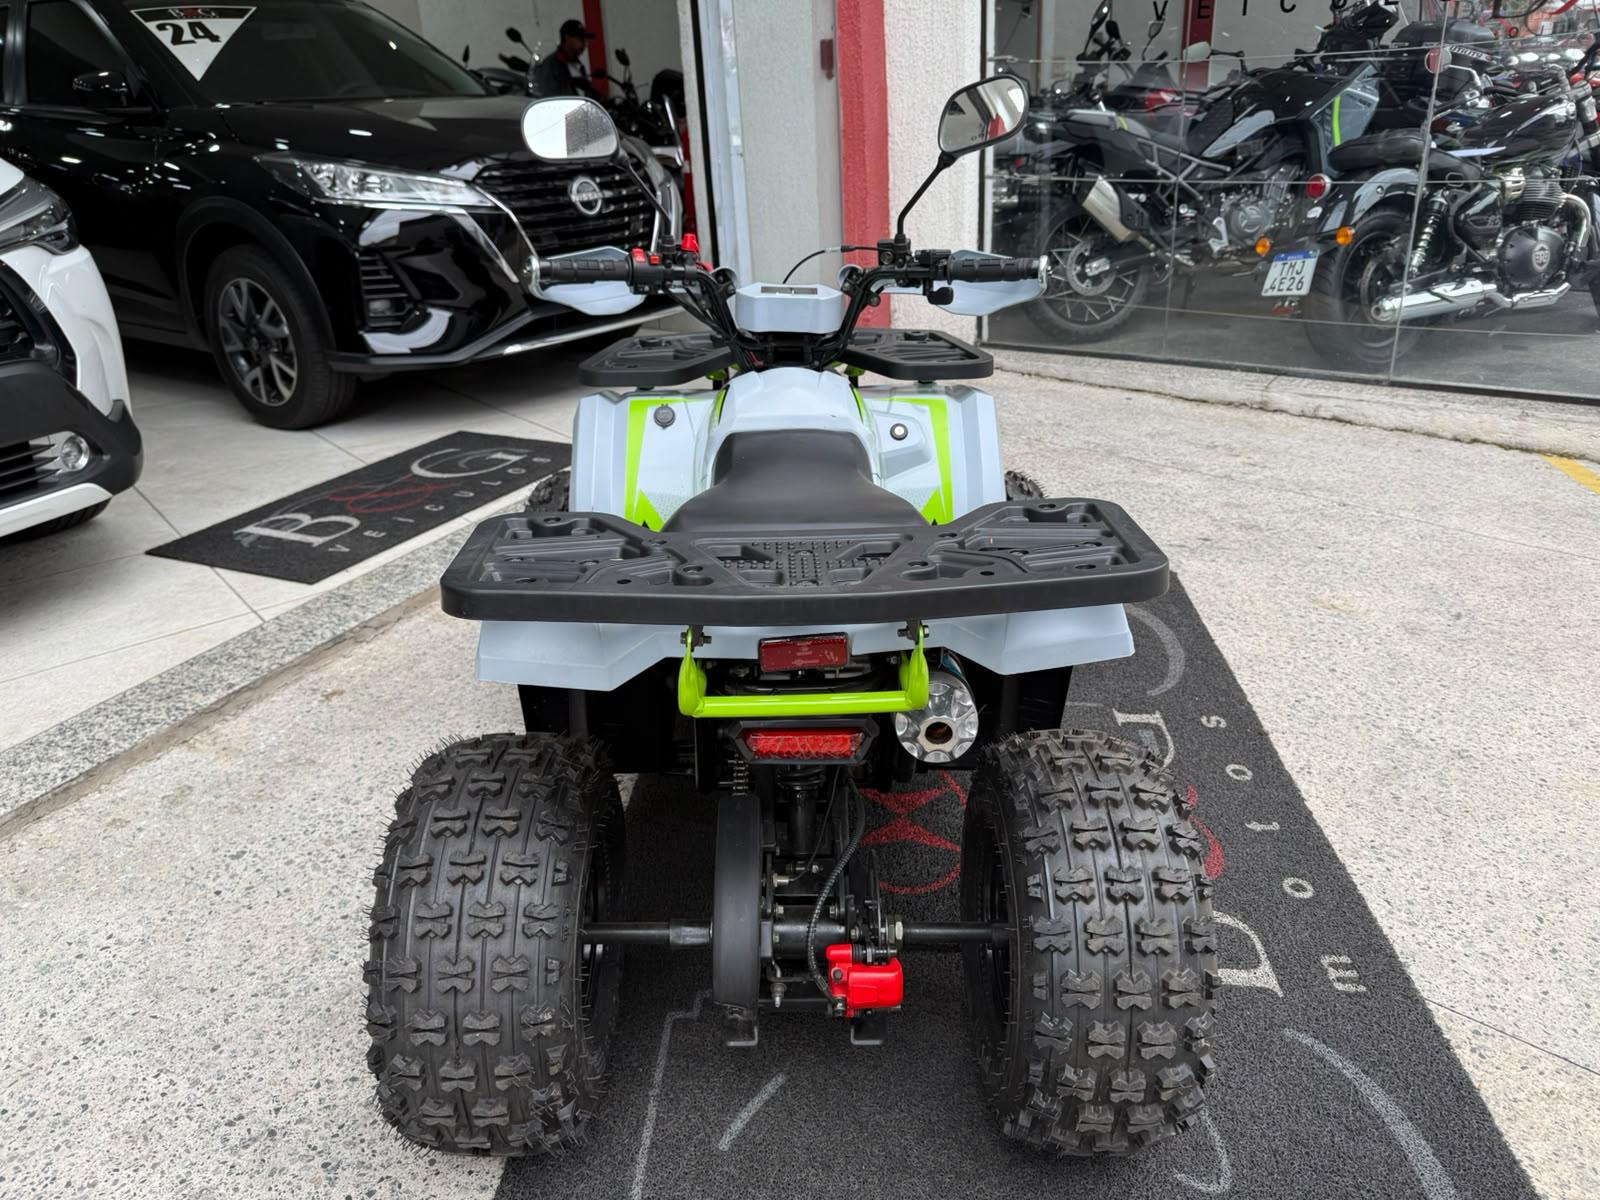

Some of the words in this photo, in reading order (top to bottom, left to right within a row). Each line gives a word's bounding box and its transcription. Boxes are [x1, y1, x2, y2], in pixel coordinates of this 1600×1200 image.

[156, 21, 221, 46] 24
[1270, 276, 1304, 292] 4E26
[328, 456, 552, 552] VEICULOS
